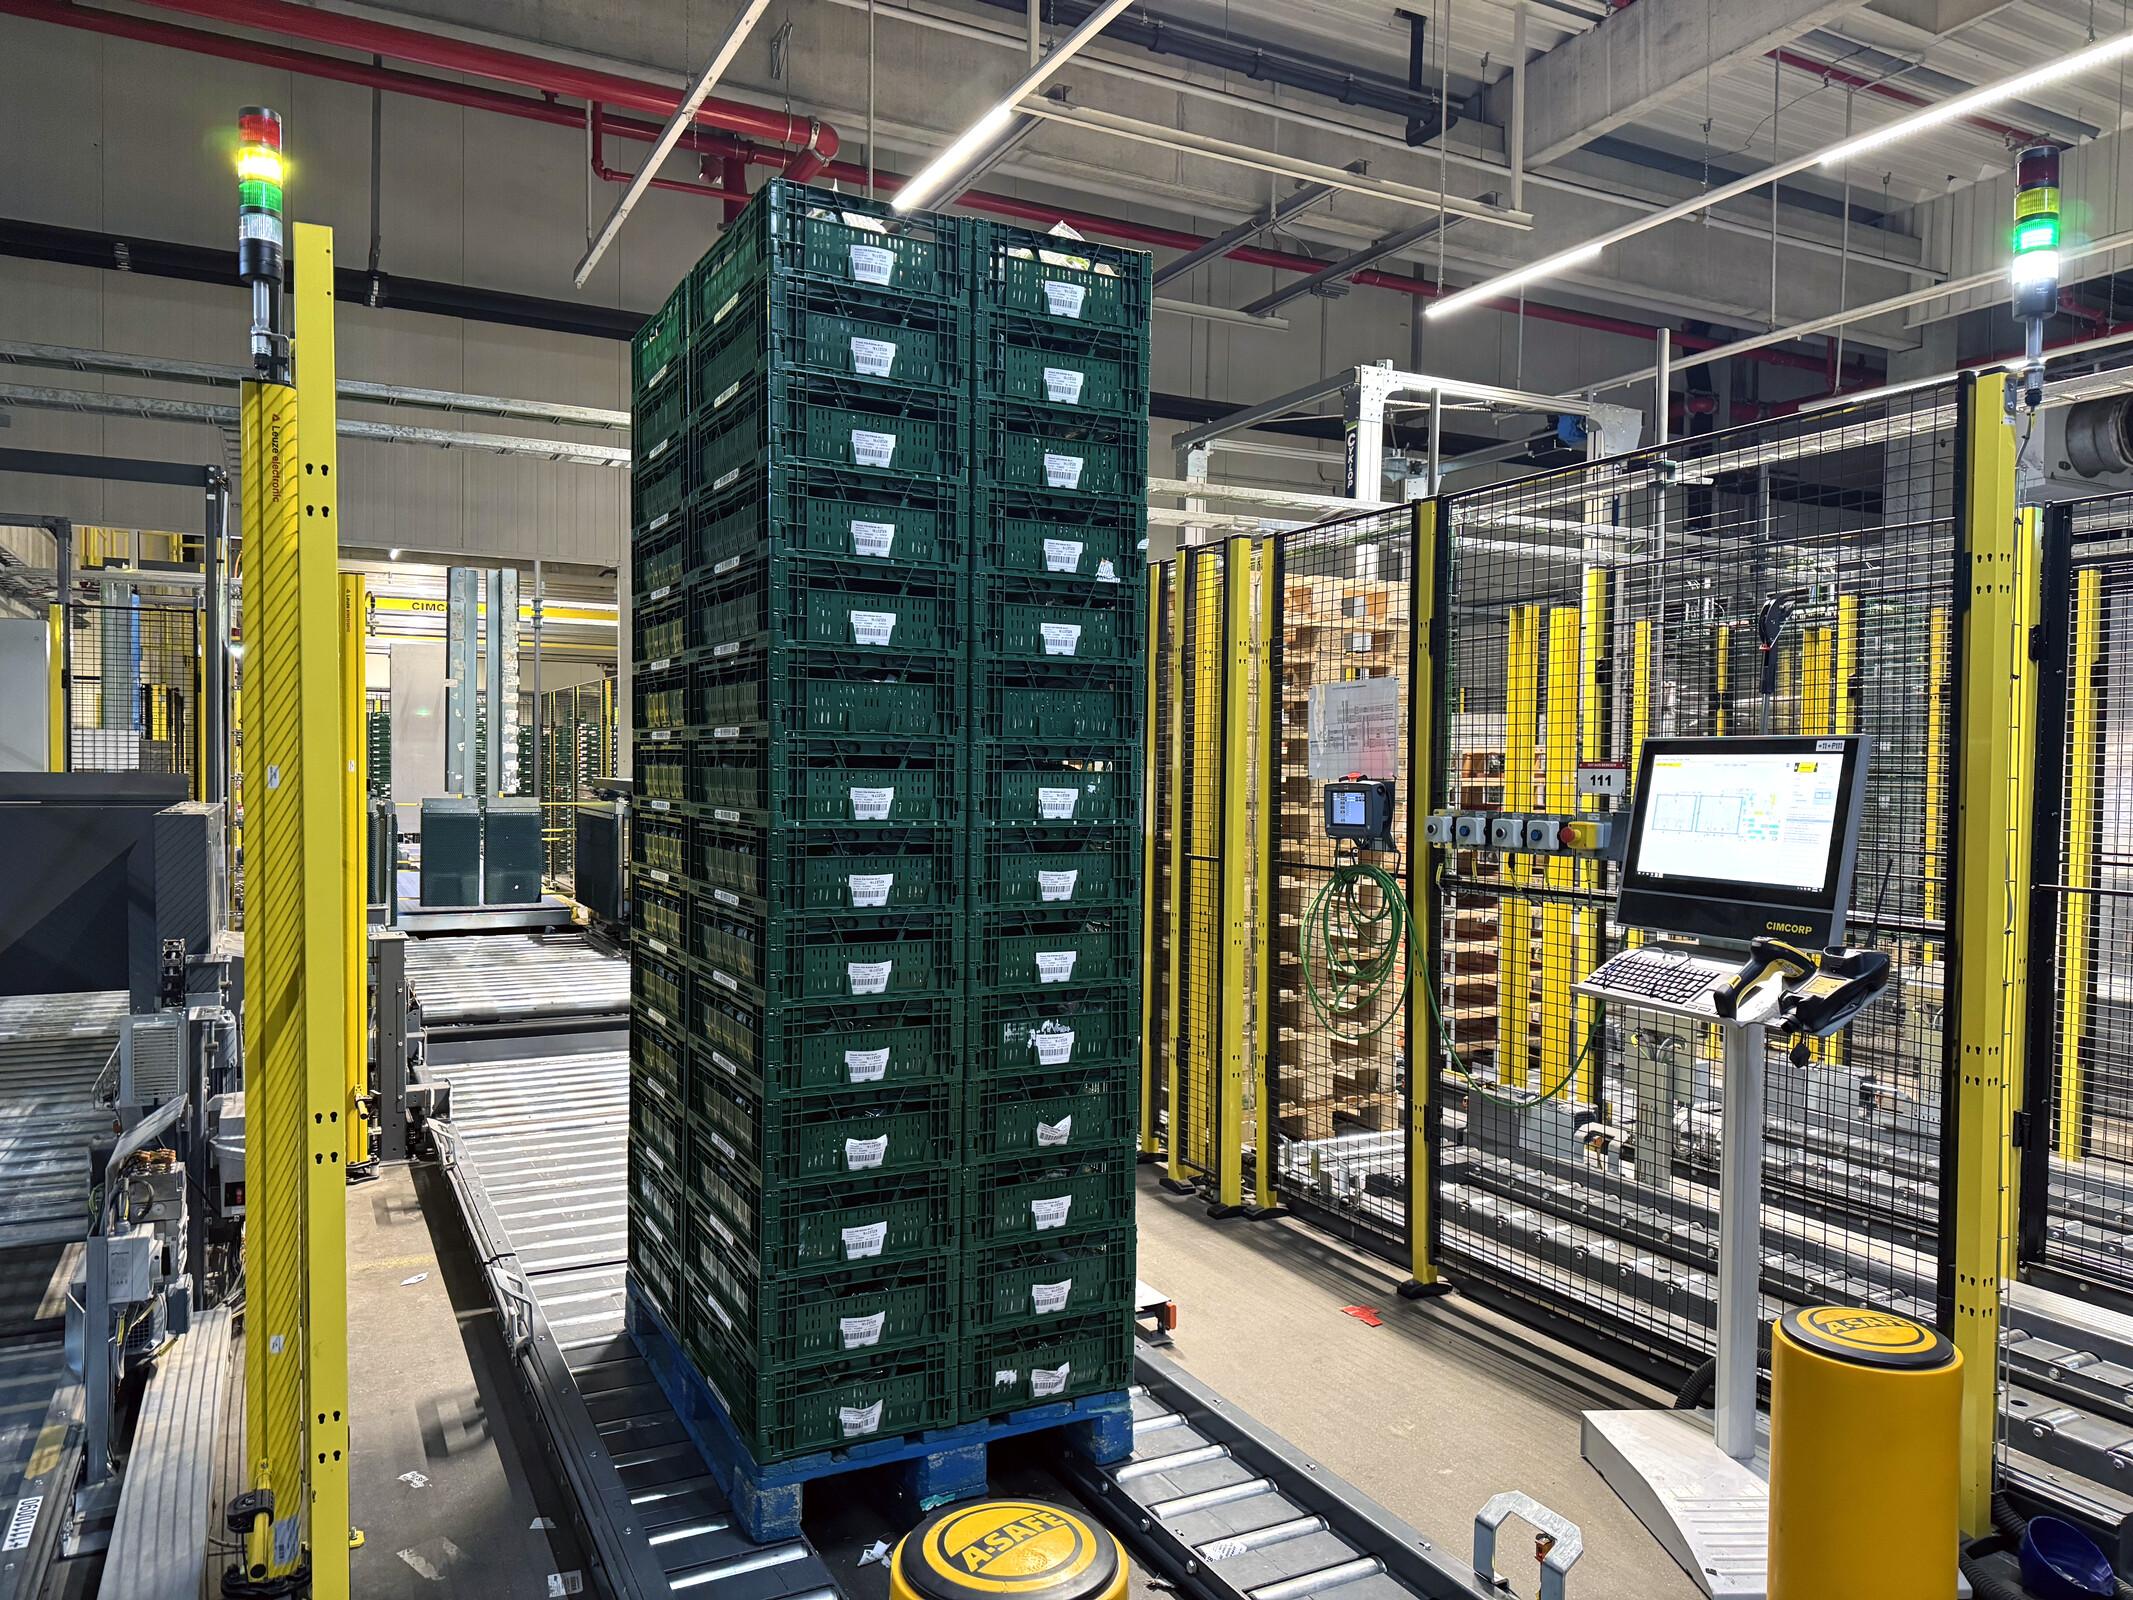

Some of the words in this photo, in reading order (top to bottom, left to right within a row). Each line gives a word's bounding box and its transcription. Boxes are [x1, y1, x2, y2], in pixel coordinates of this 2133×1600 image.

[271, 426, 281, 454] Leuze
[271, 455, 281, 503] electronic
[1347, 433, 1356, 489] CYKLOP
[411, 602, 447, 612] CIMC
[1590, 774, 1611, 786] 111
[1766, 921, 1812, 935] CIMCORP
[8, 1498, 40, 1548] +11110090
[961, 1511, 1068, 1574] A-SAFE
